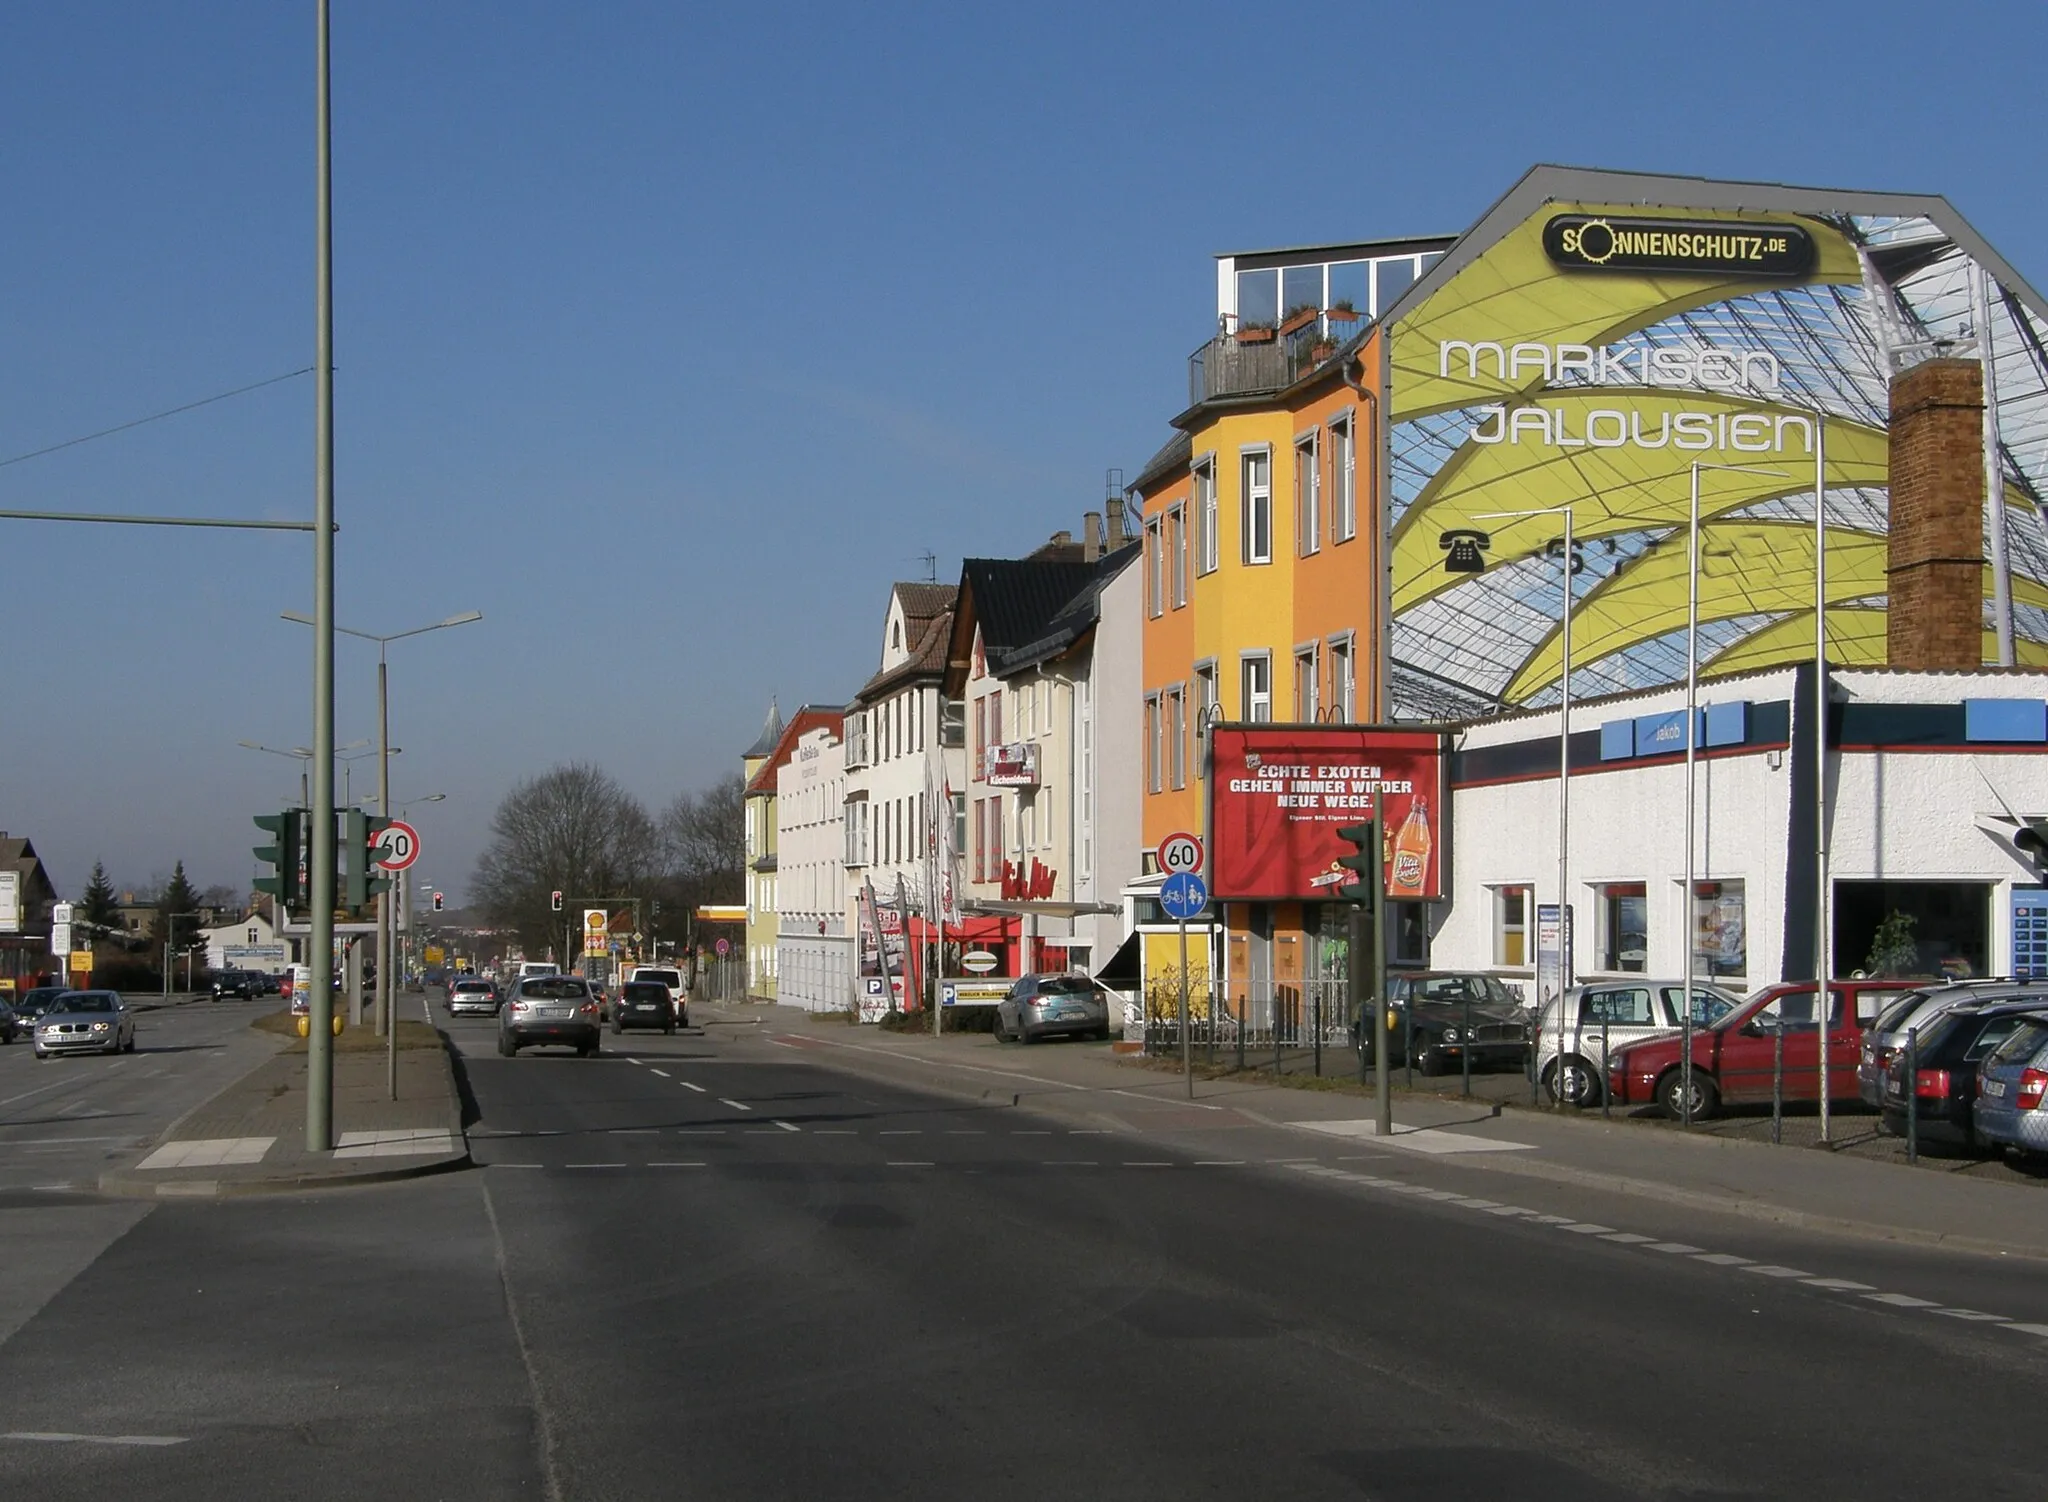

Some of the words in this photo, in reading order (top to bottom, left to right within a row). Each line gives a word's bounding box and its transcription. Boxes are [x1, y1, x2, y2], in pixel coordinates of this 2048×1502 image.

[1258, 765, 1311, 778] ECHTE
[1317, 766, 1381, 779] EXOTEN
[1229, 779, 1283, 793] GEHEN
[1291, 780, 1346, 794] IMMER
[1277, 795, 1319, 808] NEUE
[1324, 796, 1373, 809] WEGE.
[1168, 845, 1194, 867] 60
